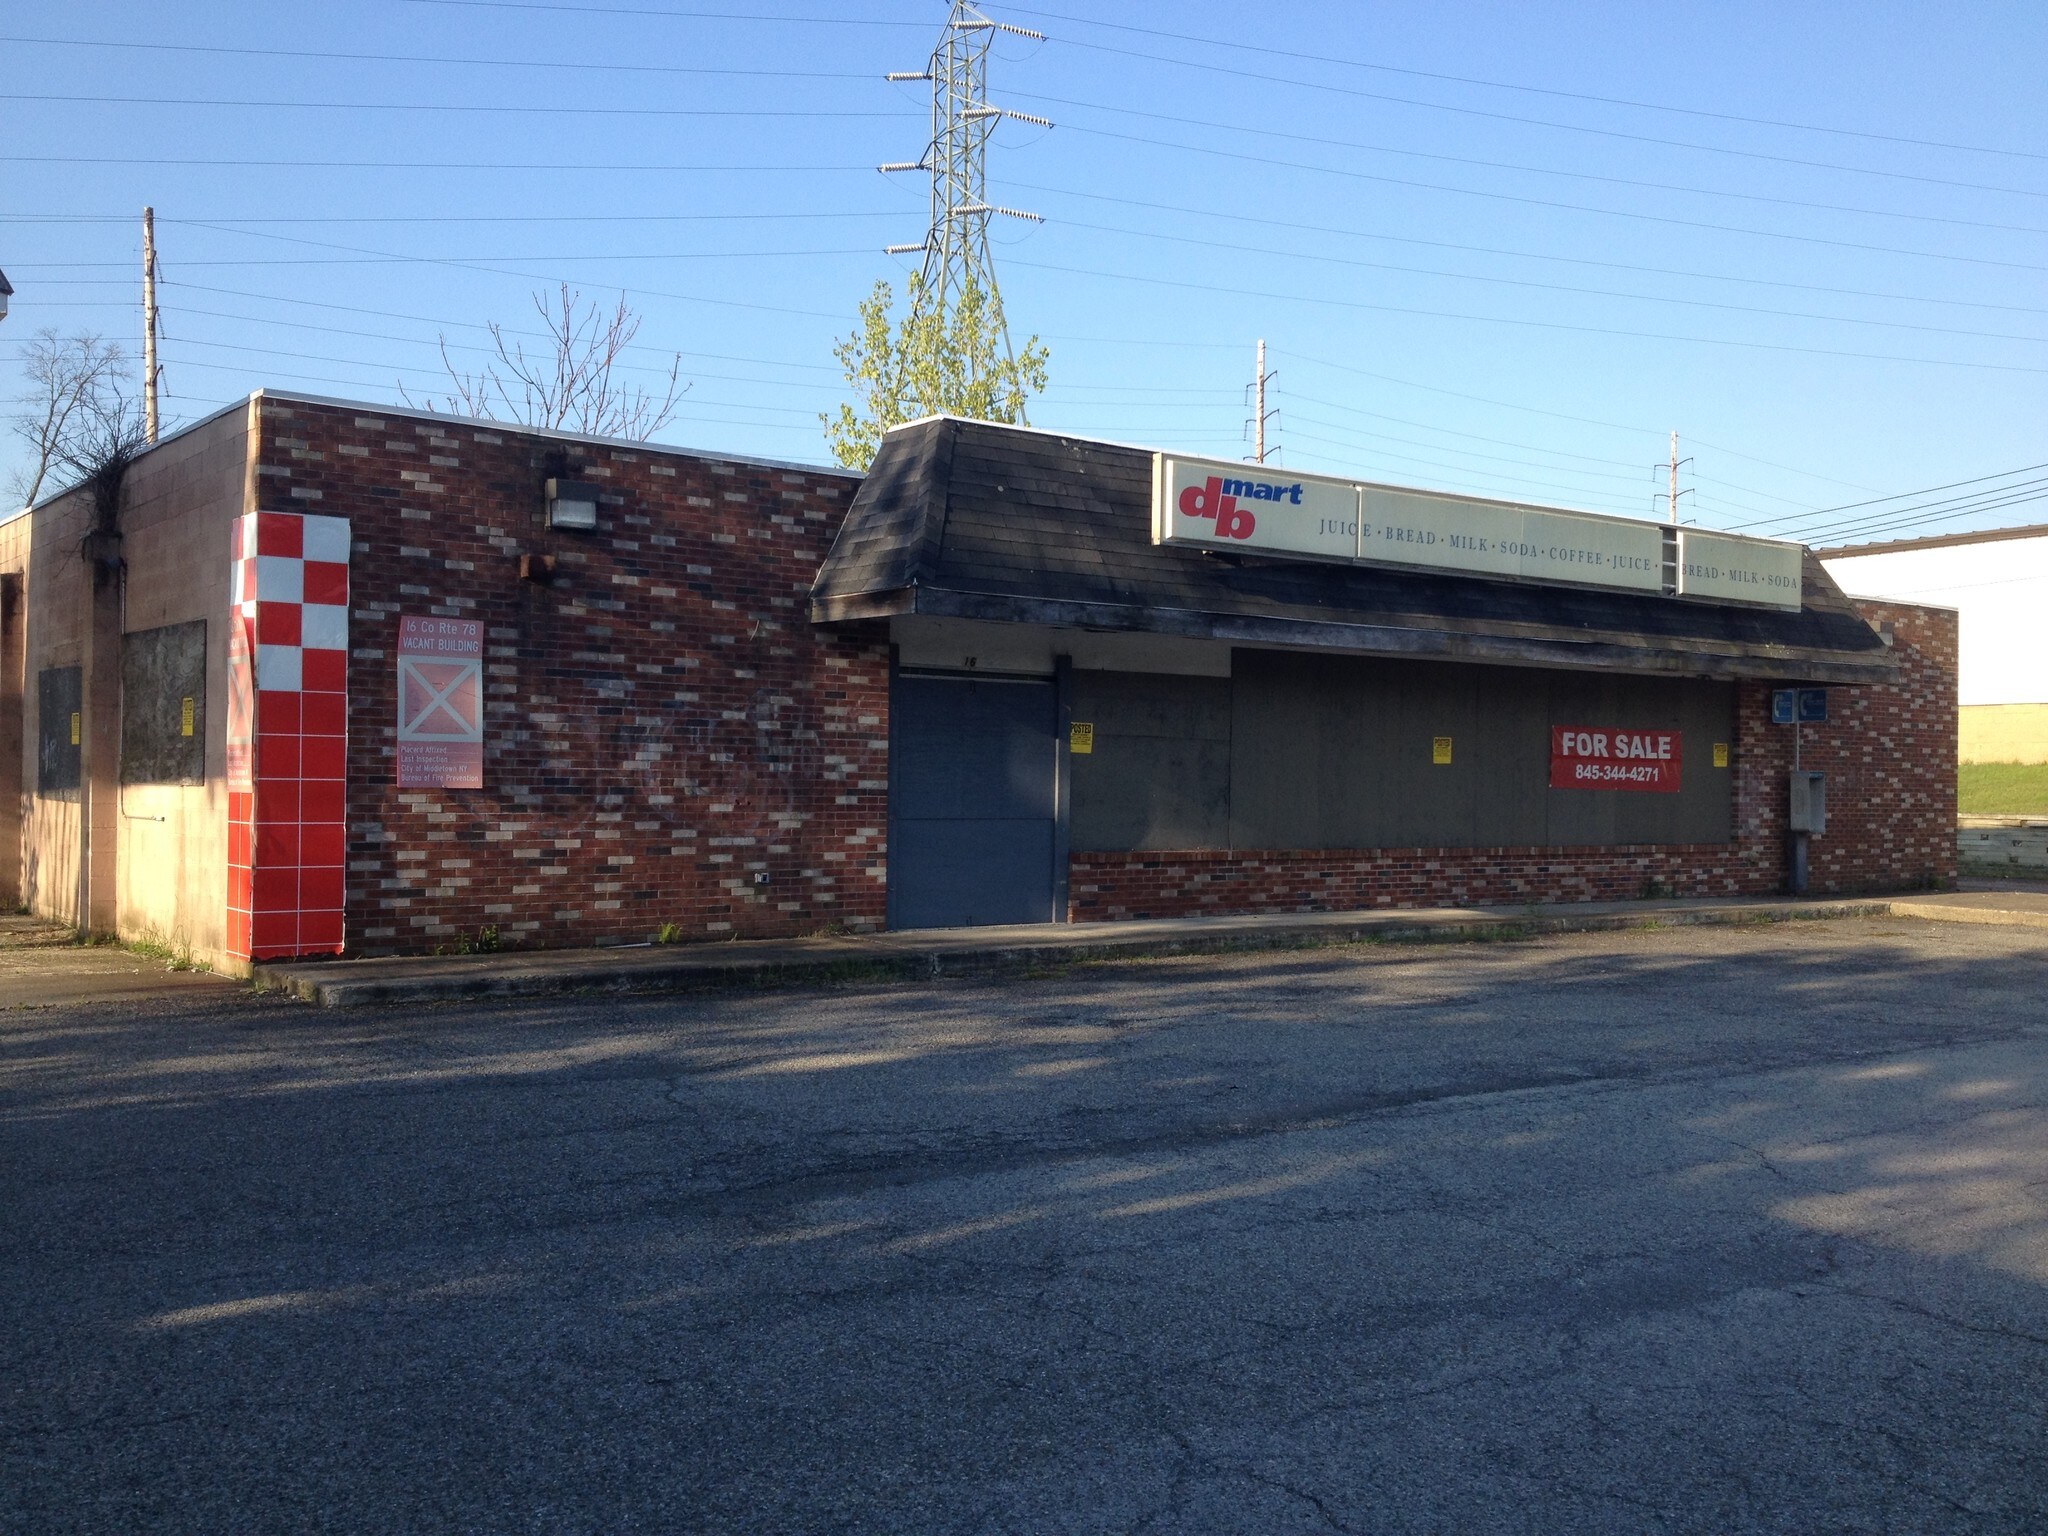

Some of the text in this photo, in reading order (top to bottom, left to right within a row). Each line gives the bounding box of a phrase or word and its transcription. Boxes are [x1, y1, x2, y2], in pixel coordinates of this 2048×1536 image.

[1222, 477, 1304, 505] mart
[1319, 519, 1651, 571] JUICE BREAD MILK SODA COFFEE JUICE
[1682, 563, 1798, 590] BREAD MILK SODA
[406, 620, 477, 636] 16 Co Rte 78
[402, 637, 479, 653] VACANT BUILDING
[965, 657, 977, 667] 16
[1071, 723, 1092, 734] POSTED
[1562, 732, 1671, 759] FOR SALE
[401, 764, 413, 773] City
[458, 765, 468, 773] NY
[1575, 764, 1659, 782] 845-344-4271
[432, 773, 444, 782] Fire
[445, 774, 479, 783] Prevention
